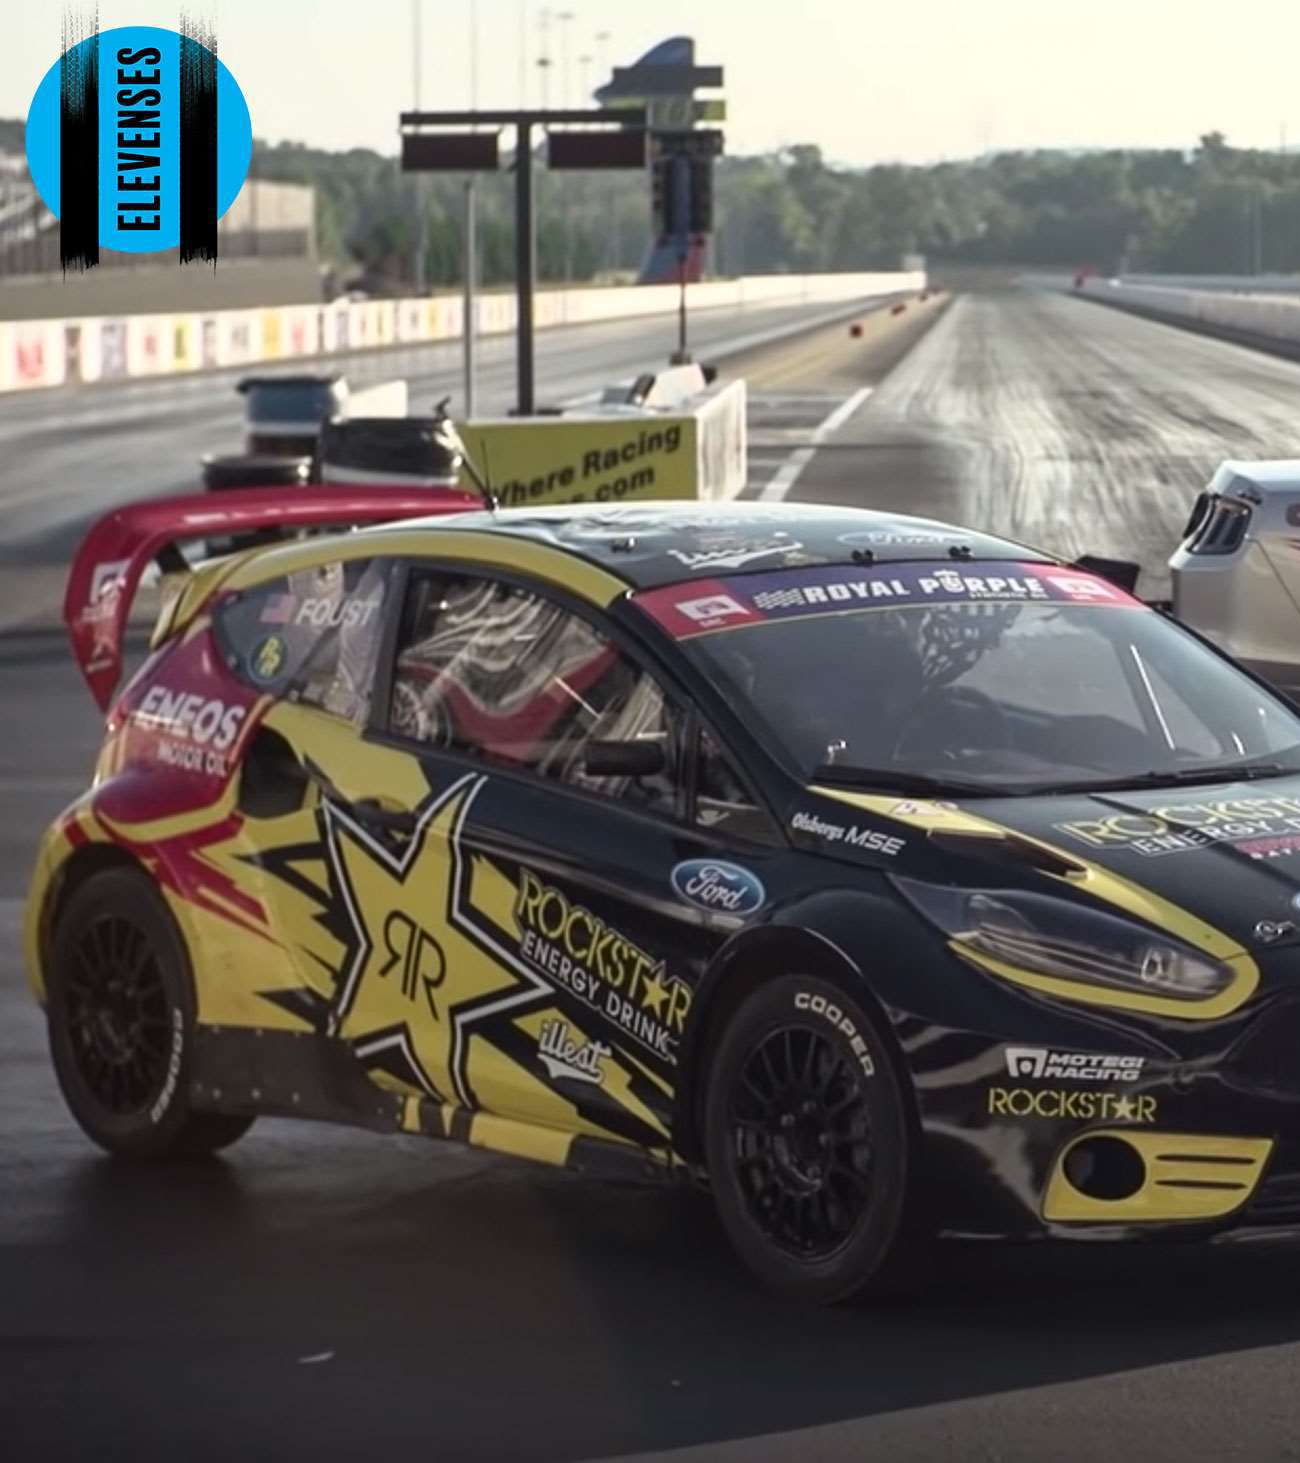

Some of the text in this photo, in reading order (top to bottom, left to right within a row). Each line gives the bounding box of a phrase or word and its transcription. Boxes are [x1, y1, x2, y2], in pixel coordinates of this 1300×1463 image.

[583, 424, 681, 477] Racing
[802, 569, 1045, 604] ROYAL PURPLE
[295, 599, 381, 626] FOUST
[138, 686, 248, 750] ENEOS
[157, 741, 229, 778] MOTOR OIL
[846, 825, 906, 856] MSE
[1135, 820, 1272, 852] ENERGY
[685, 864, 748, 910] Ford
[523, 930, 673, 1053] ENERGY DRINK
[539, 1020, 612, 1076] illest
[794, 992, 875, 1078] COOPER
[1043, 1066, 1140, 1082] RACING
[1049, 1054, 1145, 1069] MOTEGI
